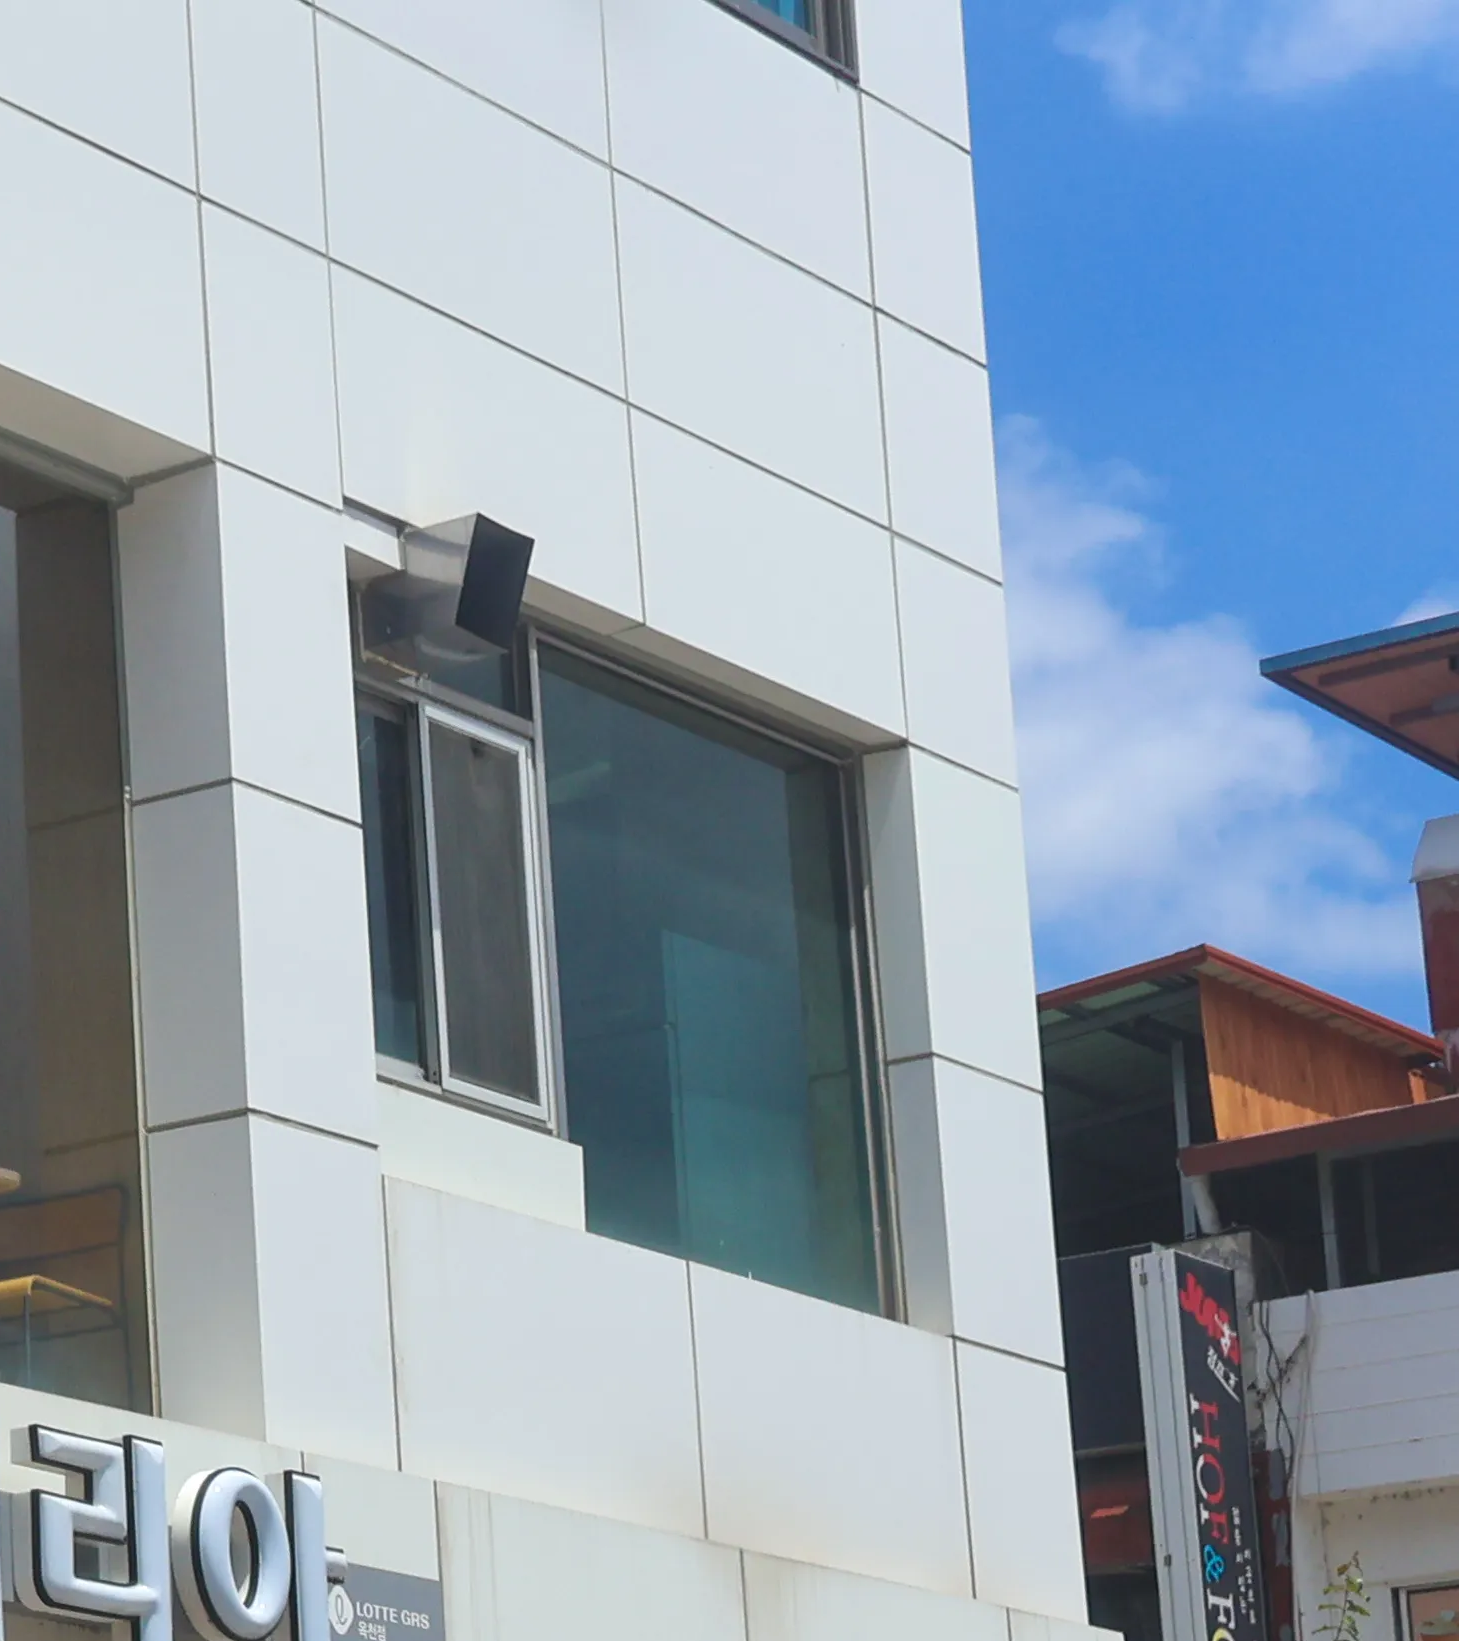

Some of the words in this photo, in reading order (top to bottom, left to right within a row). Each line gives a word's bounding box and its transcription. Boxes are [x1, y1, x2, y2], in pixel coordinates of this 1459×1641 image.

[1189, 1393, 1230, 1546] HOF
[356, 1601, 398, 1624] LOTTE
[401, 1608, 430, 1630] GRS
